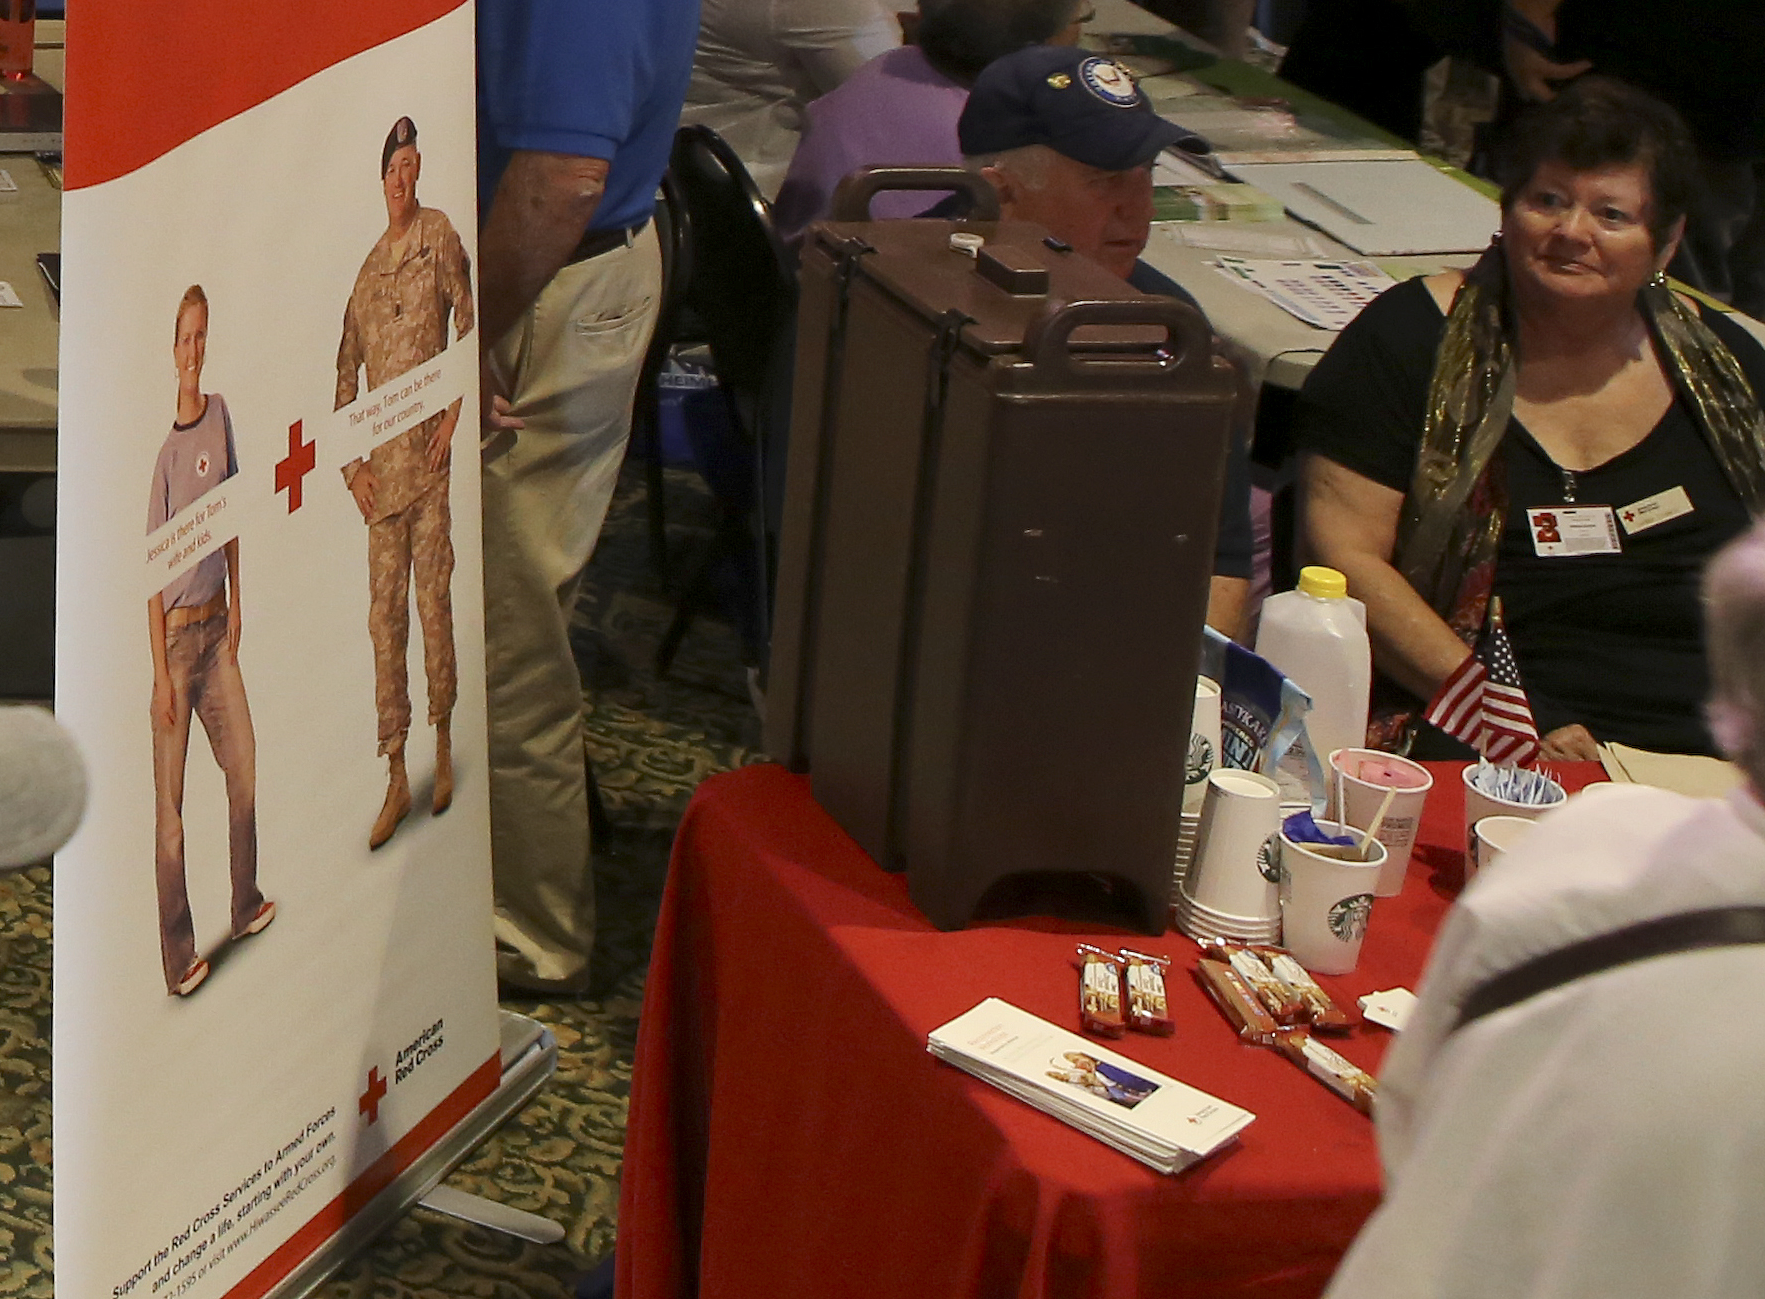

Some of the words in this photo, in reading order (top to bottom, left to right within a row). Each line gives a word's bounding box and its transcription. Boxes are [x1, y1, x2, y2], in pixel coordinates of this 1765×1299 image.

[349, 407, 366, 427] That
[366, 401, 382, 421] way,
[382, 390, 400, 413] Tom
[399, 385, 413, 402] can
[413, 377, 423, 395] be
[422, 368, 442, 392] there
[372, 419, 383, 438] for
[383, 413, 396, 430] our
[146, 535, 170, 565] Jessica
[176, 519, 195, 543] there
[194, 511, 206, 530] for
[206, 495, 227, 524] Tom's
[167, 547, 183, 571] wife
[182, 538, 195, 560] and
[395, 1018, 444, 1067] American
[395, 1056, 415, 1085] Red
[415, 1036, 445, 1066] Cross
[112, 1257, 153, 1299] Support
[154, 1245, 170, 1268] the
[171, 1226, 191, 1253] Red
[192, 1205, 221, 1234] Cross
[222, 1169, 263, 1209] Services
[263, 1156, 274, 1174] to
[274, 1130, 305, 1166] Armed
[305, 1105, 338, 1140] Forces
[151, 1271, 171, 1295] and
[172, 1240, 209, 1278] change
[209, 1232, 217, 1246] a
[236, 1183, 273, 1224] starting
[272, 1166, 293, 1191] with
[292, 1150, 316, 1180] your
[315, 1130, 337, 1155] own.
[197, 1264, 208, 1280] or
[207, 1246, 226, 1271] visit
